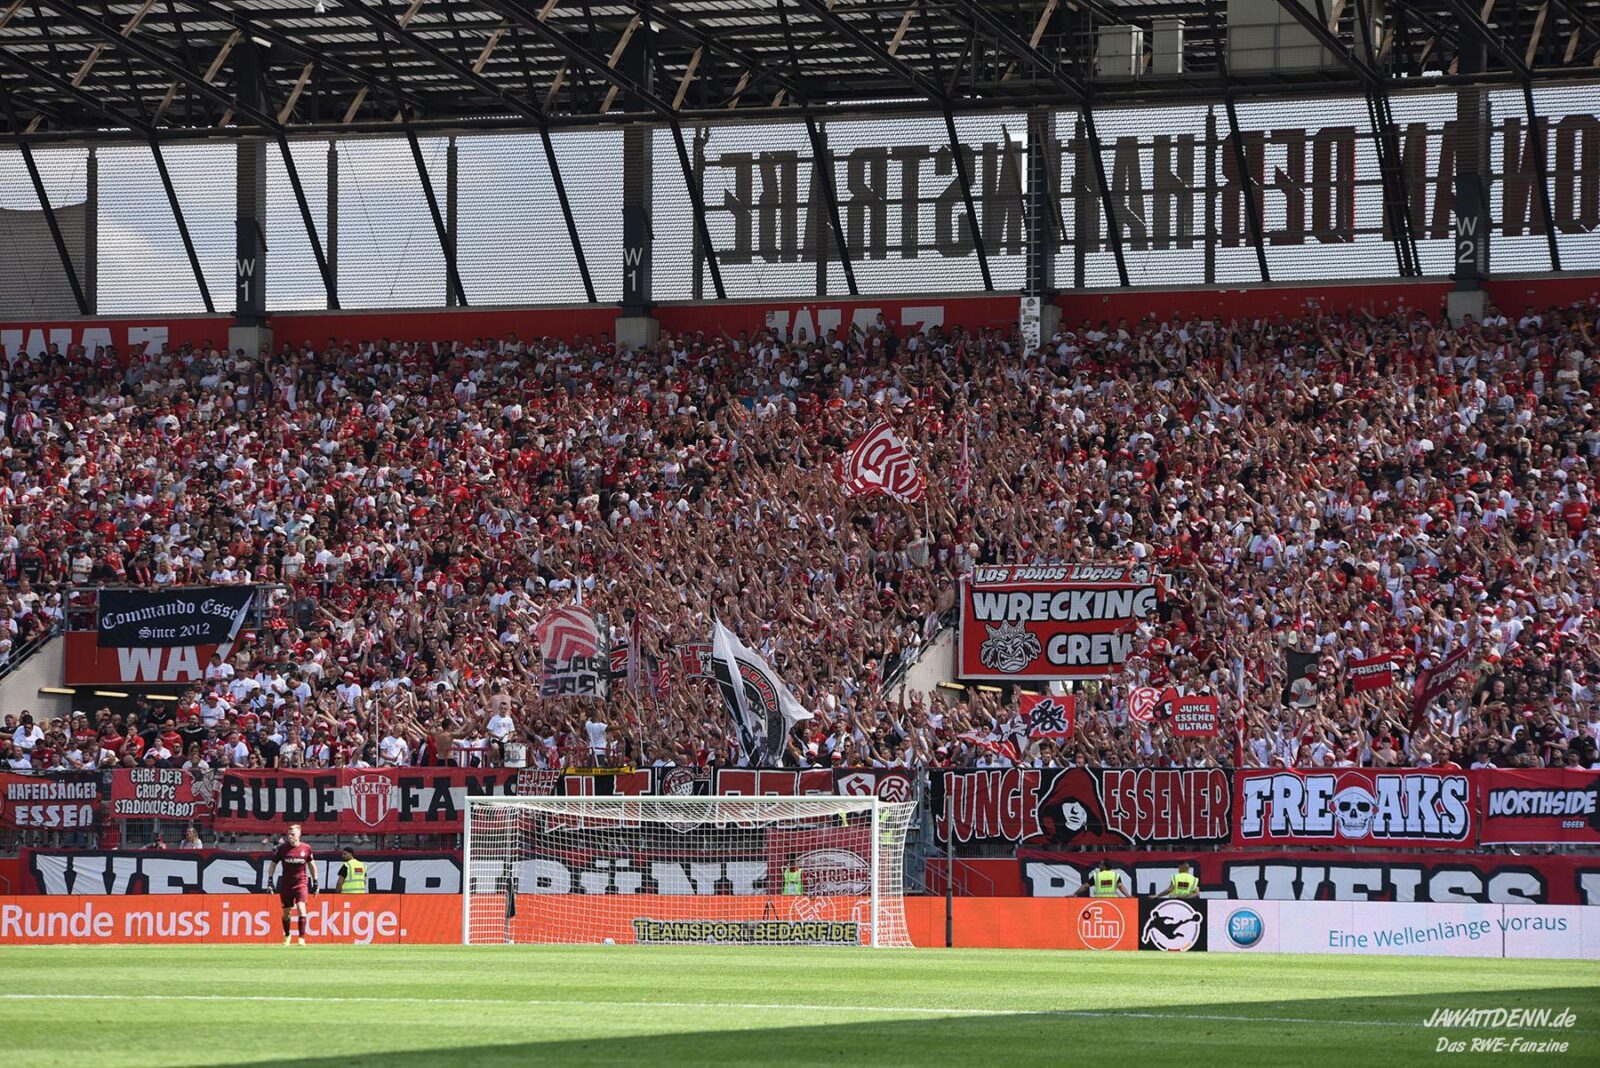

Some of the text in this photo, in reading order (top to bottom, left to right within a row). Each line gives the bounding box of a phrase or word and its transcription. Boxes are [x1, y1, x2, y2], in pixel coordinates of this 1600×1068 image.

[1456, 217, 1478, 237] W
[623, 247, 644, 267] W
[1458, 242, 1475, 264] 2
[236, 258, 256, 277] W
[240, 280, 250, 302] 1
[628, 270, 637, 292] 1
[976, 568, 1009, 583] LOS
[1070, 565, 1125, 581] LOCOS
[102, 598, 241, 631] Commando Esse
[973, 587, 1157, 621] WRECKING
[138, 623, 211, 640] Since 2012
[1174, 713, 1215, 722] ESSENER
[1179, 704, 1211, 713] JUNGE
[1177, 722, 1214, 731] ULTRAS
[130, 768, 183, 785] EHRE DER
[8, 779, 97, 800] HAFENSÄNGER
[136, 784, 176, 800] GRUPPE
[218, 775, 338, 822] RUDE
[936, 768, 1231, 843] JUNGE ESSENER
[1489, 789, 1598, 817] NORTHSIDE
[15, 804, 93, 827] ESSEN
[1, 902, 114, 937] Runde
[125, 911, 210, 937] muss
[221, 902, 270, 936] ins
[1082, 907, 1120, 939] ifm
[1232, 918, 1258, 931] SPT
[1328, 916, 1568, 948] Eine Wellenlänge voraus
